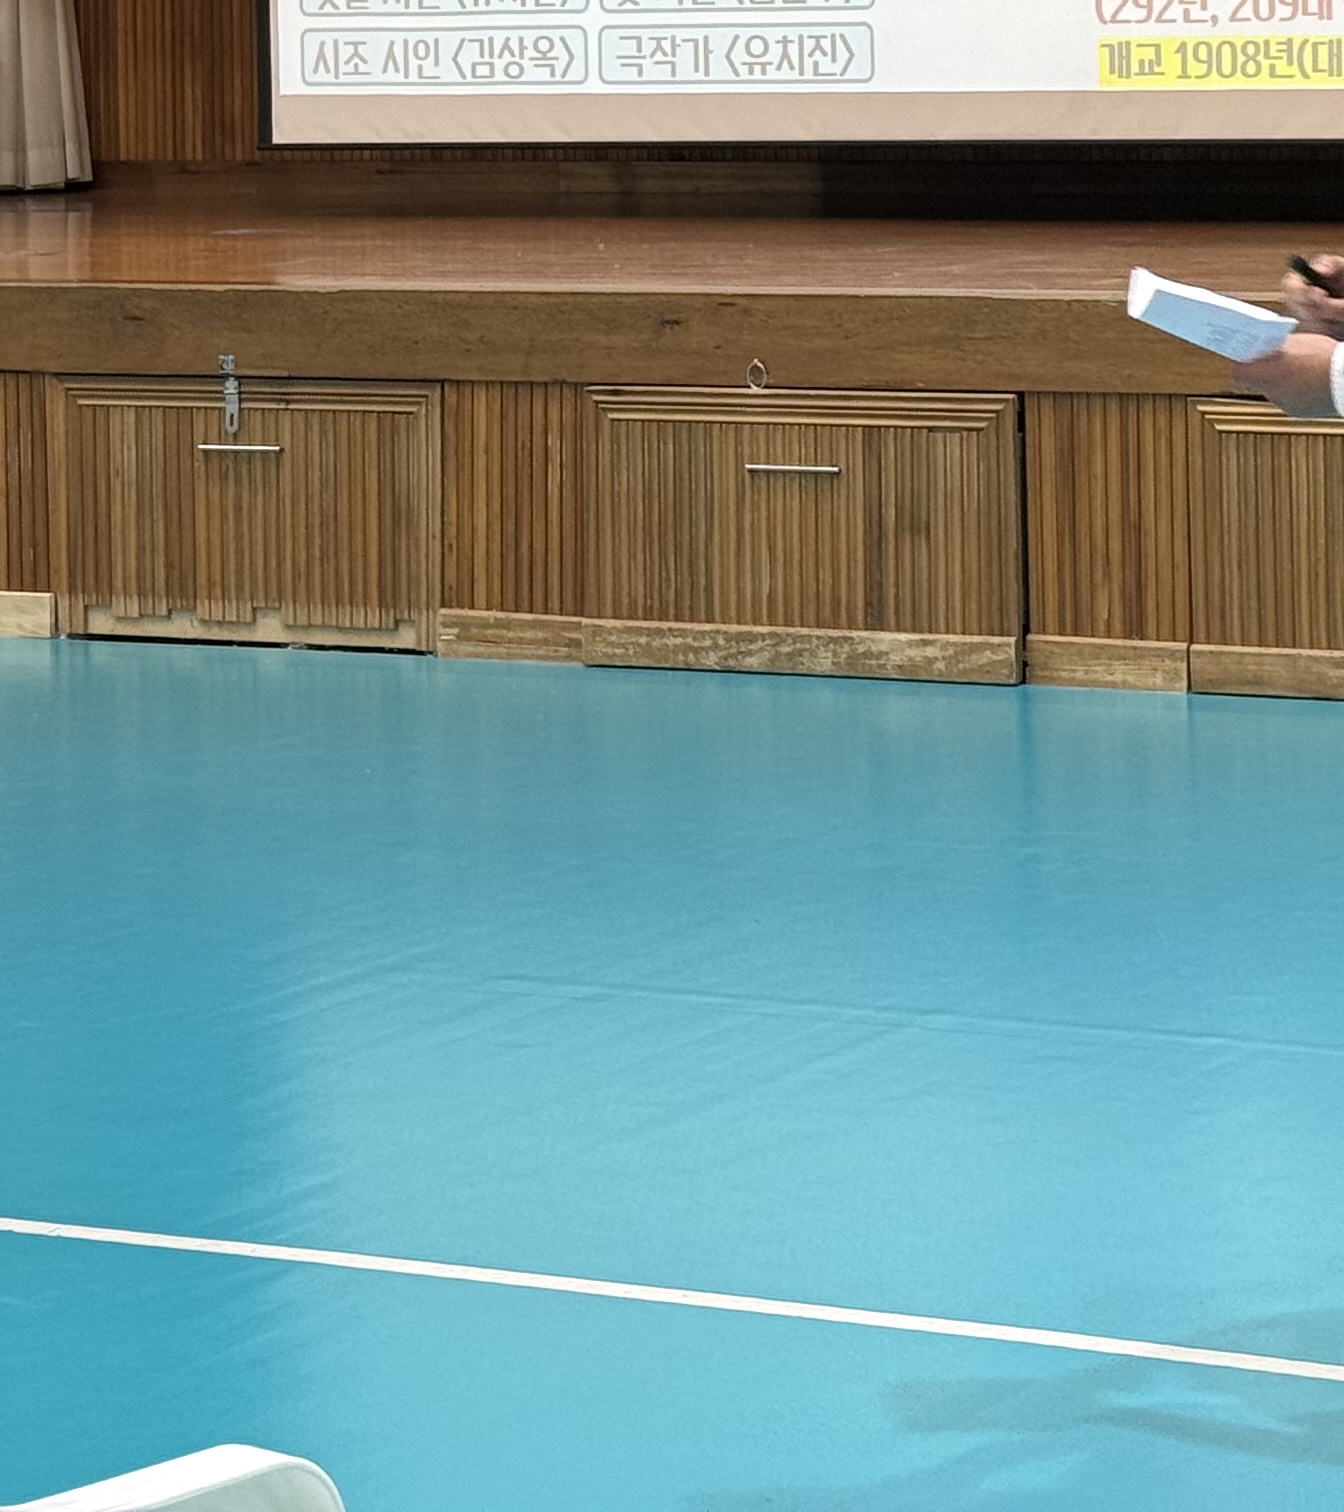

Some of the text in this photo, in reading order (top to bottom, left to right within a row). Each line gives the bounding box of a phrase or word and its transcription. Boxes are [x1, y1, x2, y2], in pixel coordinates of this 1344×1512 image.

[311, 36, 371, 80] 시조
[382, 37, 441, 81] 시인
[616, 35, 714, 79] 극작가
[1101, 40, 1165, 79] 개교
